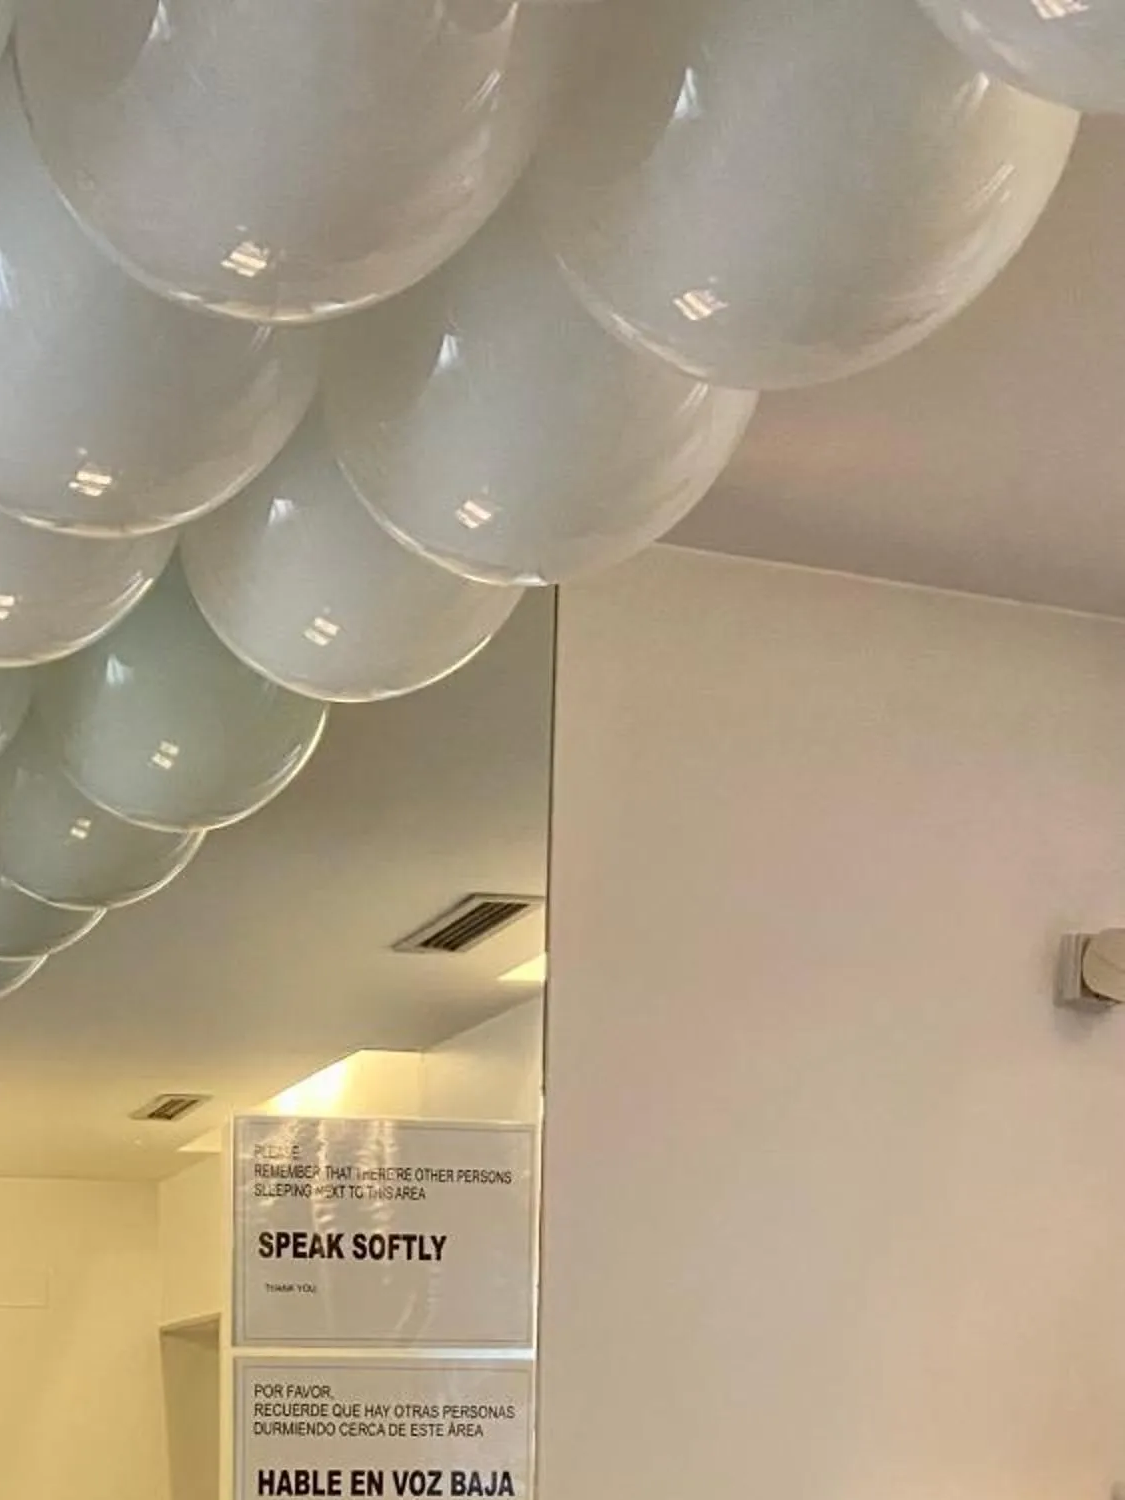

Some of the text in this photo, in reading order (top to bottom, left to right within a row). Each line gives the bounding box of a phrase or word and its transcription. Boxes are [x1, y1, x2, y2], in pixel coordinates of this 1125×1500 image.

[325, 1165, 352, 1180] THAT
[414, 1167, 454, 1183] OTHER
[456, 1168, 512, 1185] PERSONS
[394, 1185, 425, 1201] AREA
[258, 1231, 447, 1261] SPEAK SOFTLY
[253, 1384, 284, 1398] POR
[253, 1403, 515, 1420] RECUERDE QUE HAY OTRAS PERSONAS
[253, 1422, 336, 1437] DURMIENDO
[338, 1422, 386, 1437] CERCA
[388, 1423, 406, 1437] DE
[410, 1423, 444, 1437] ESTE
[257, 1469, 515, 1498] HABLE EN VOZ BAJA
